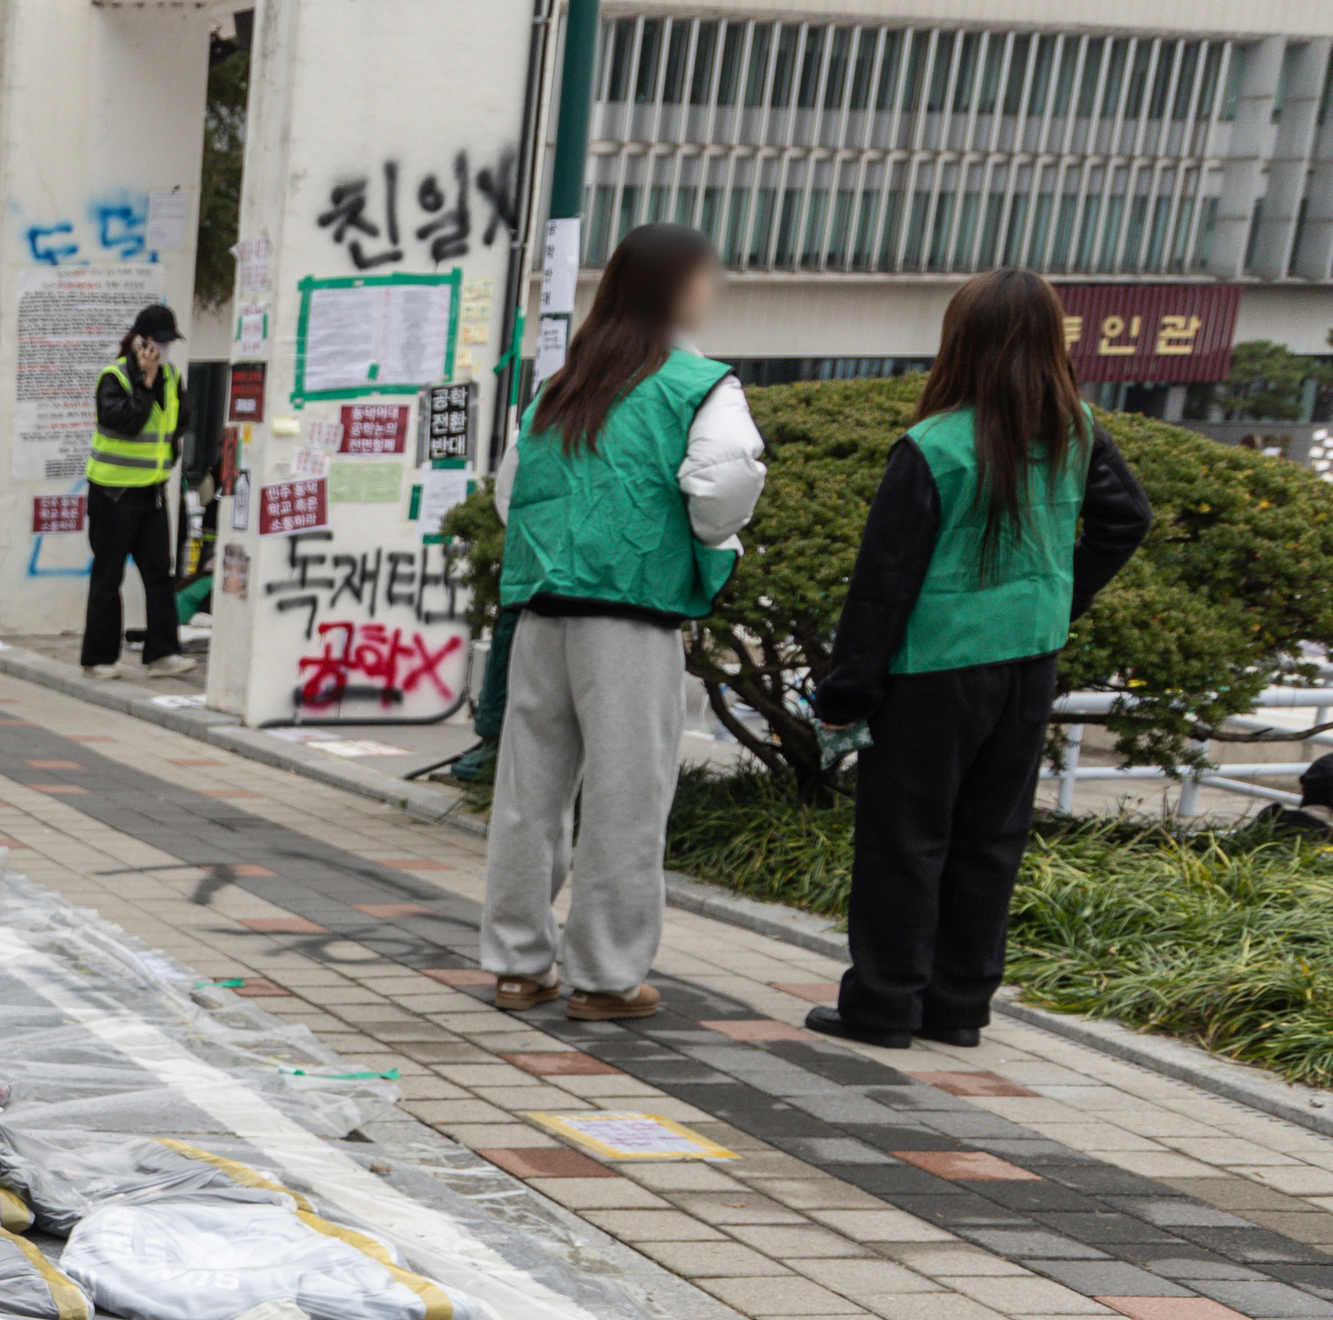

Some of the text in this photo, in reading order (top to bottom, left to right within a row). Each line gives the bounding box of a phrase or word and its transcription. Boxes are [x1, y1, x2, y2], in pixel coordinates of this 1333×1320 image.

[432, 388, 468, 411] 공학
[431, 413, 467, 435] 전환
[431, 435, 466, 458] 반대
[299, 620, 463, 710] 공학X
